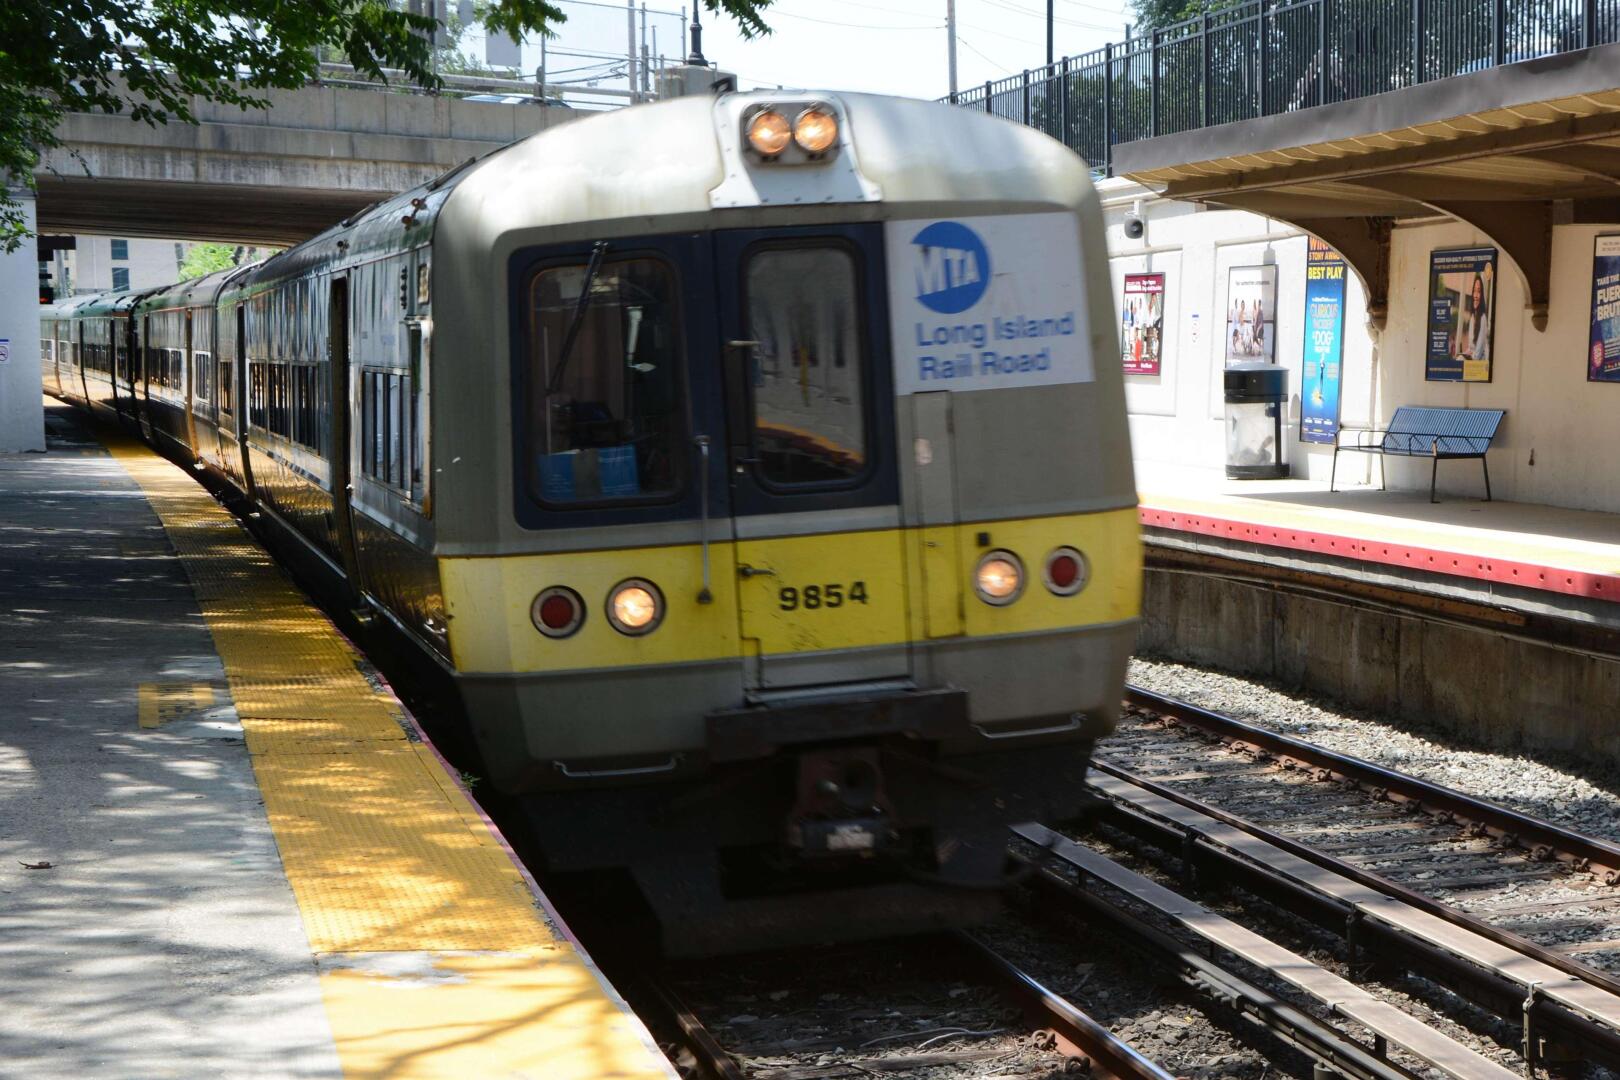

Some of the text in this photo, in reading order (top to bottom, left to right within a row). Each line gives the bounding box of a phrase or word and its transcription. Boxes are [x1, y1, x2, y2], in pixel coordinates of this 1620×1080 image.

[911, 243, 982, 298] MTA
[1308, 266, 1326, 280] BEST
[915, 312, 1074, 349] Long Island
[918, 348, 1050, 381] Rail Road
[779, 581, 868, 611] 9854
